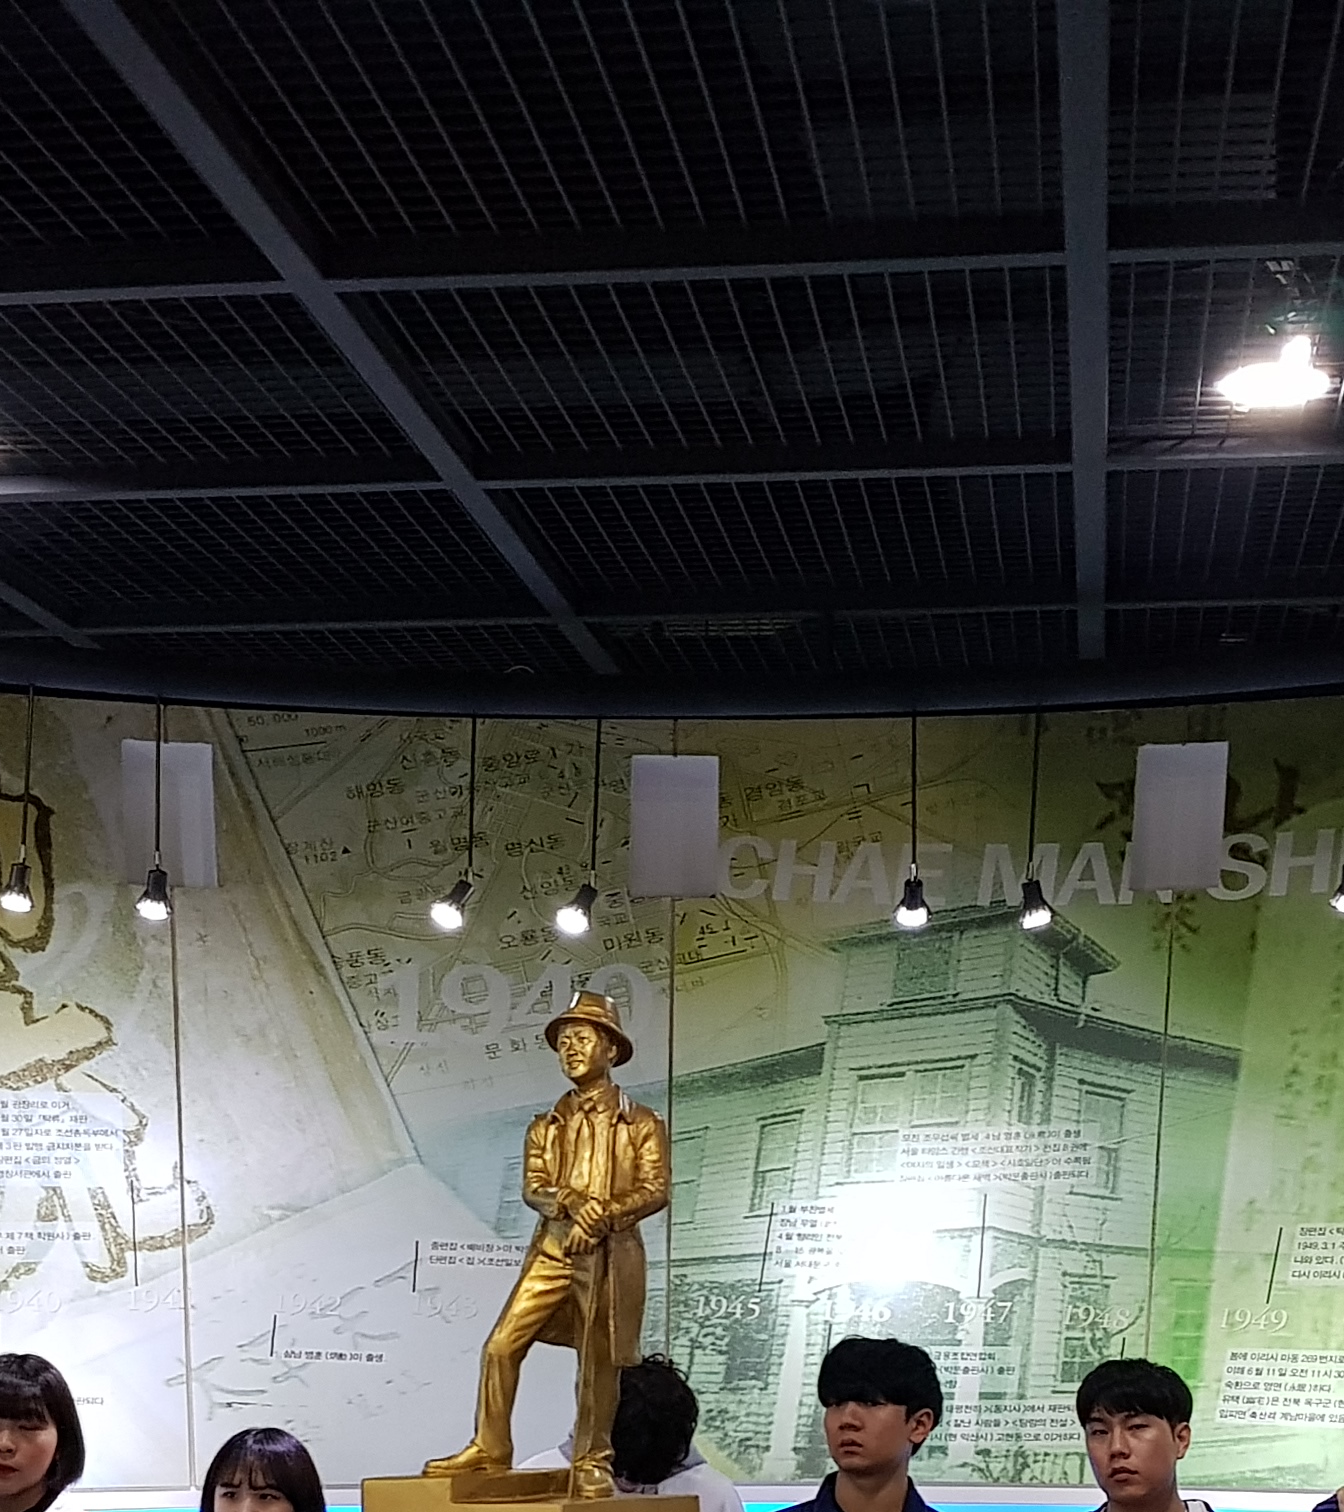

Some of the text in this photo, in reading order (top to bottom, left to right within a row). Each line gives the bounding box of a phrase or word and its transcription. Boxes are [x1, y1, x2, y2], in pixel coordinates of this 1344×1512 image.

[717, 836, 954, 906] CHAE
[276, 1293, 343, 1316] 1942
[695, 1297, 761, 1321] 1945
[944, 1300, 1013, 1324] 1947
[1220, 1306, 1289, 1332] 1949
